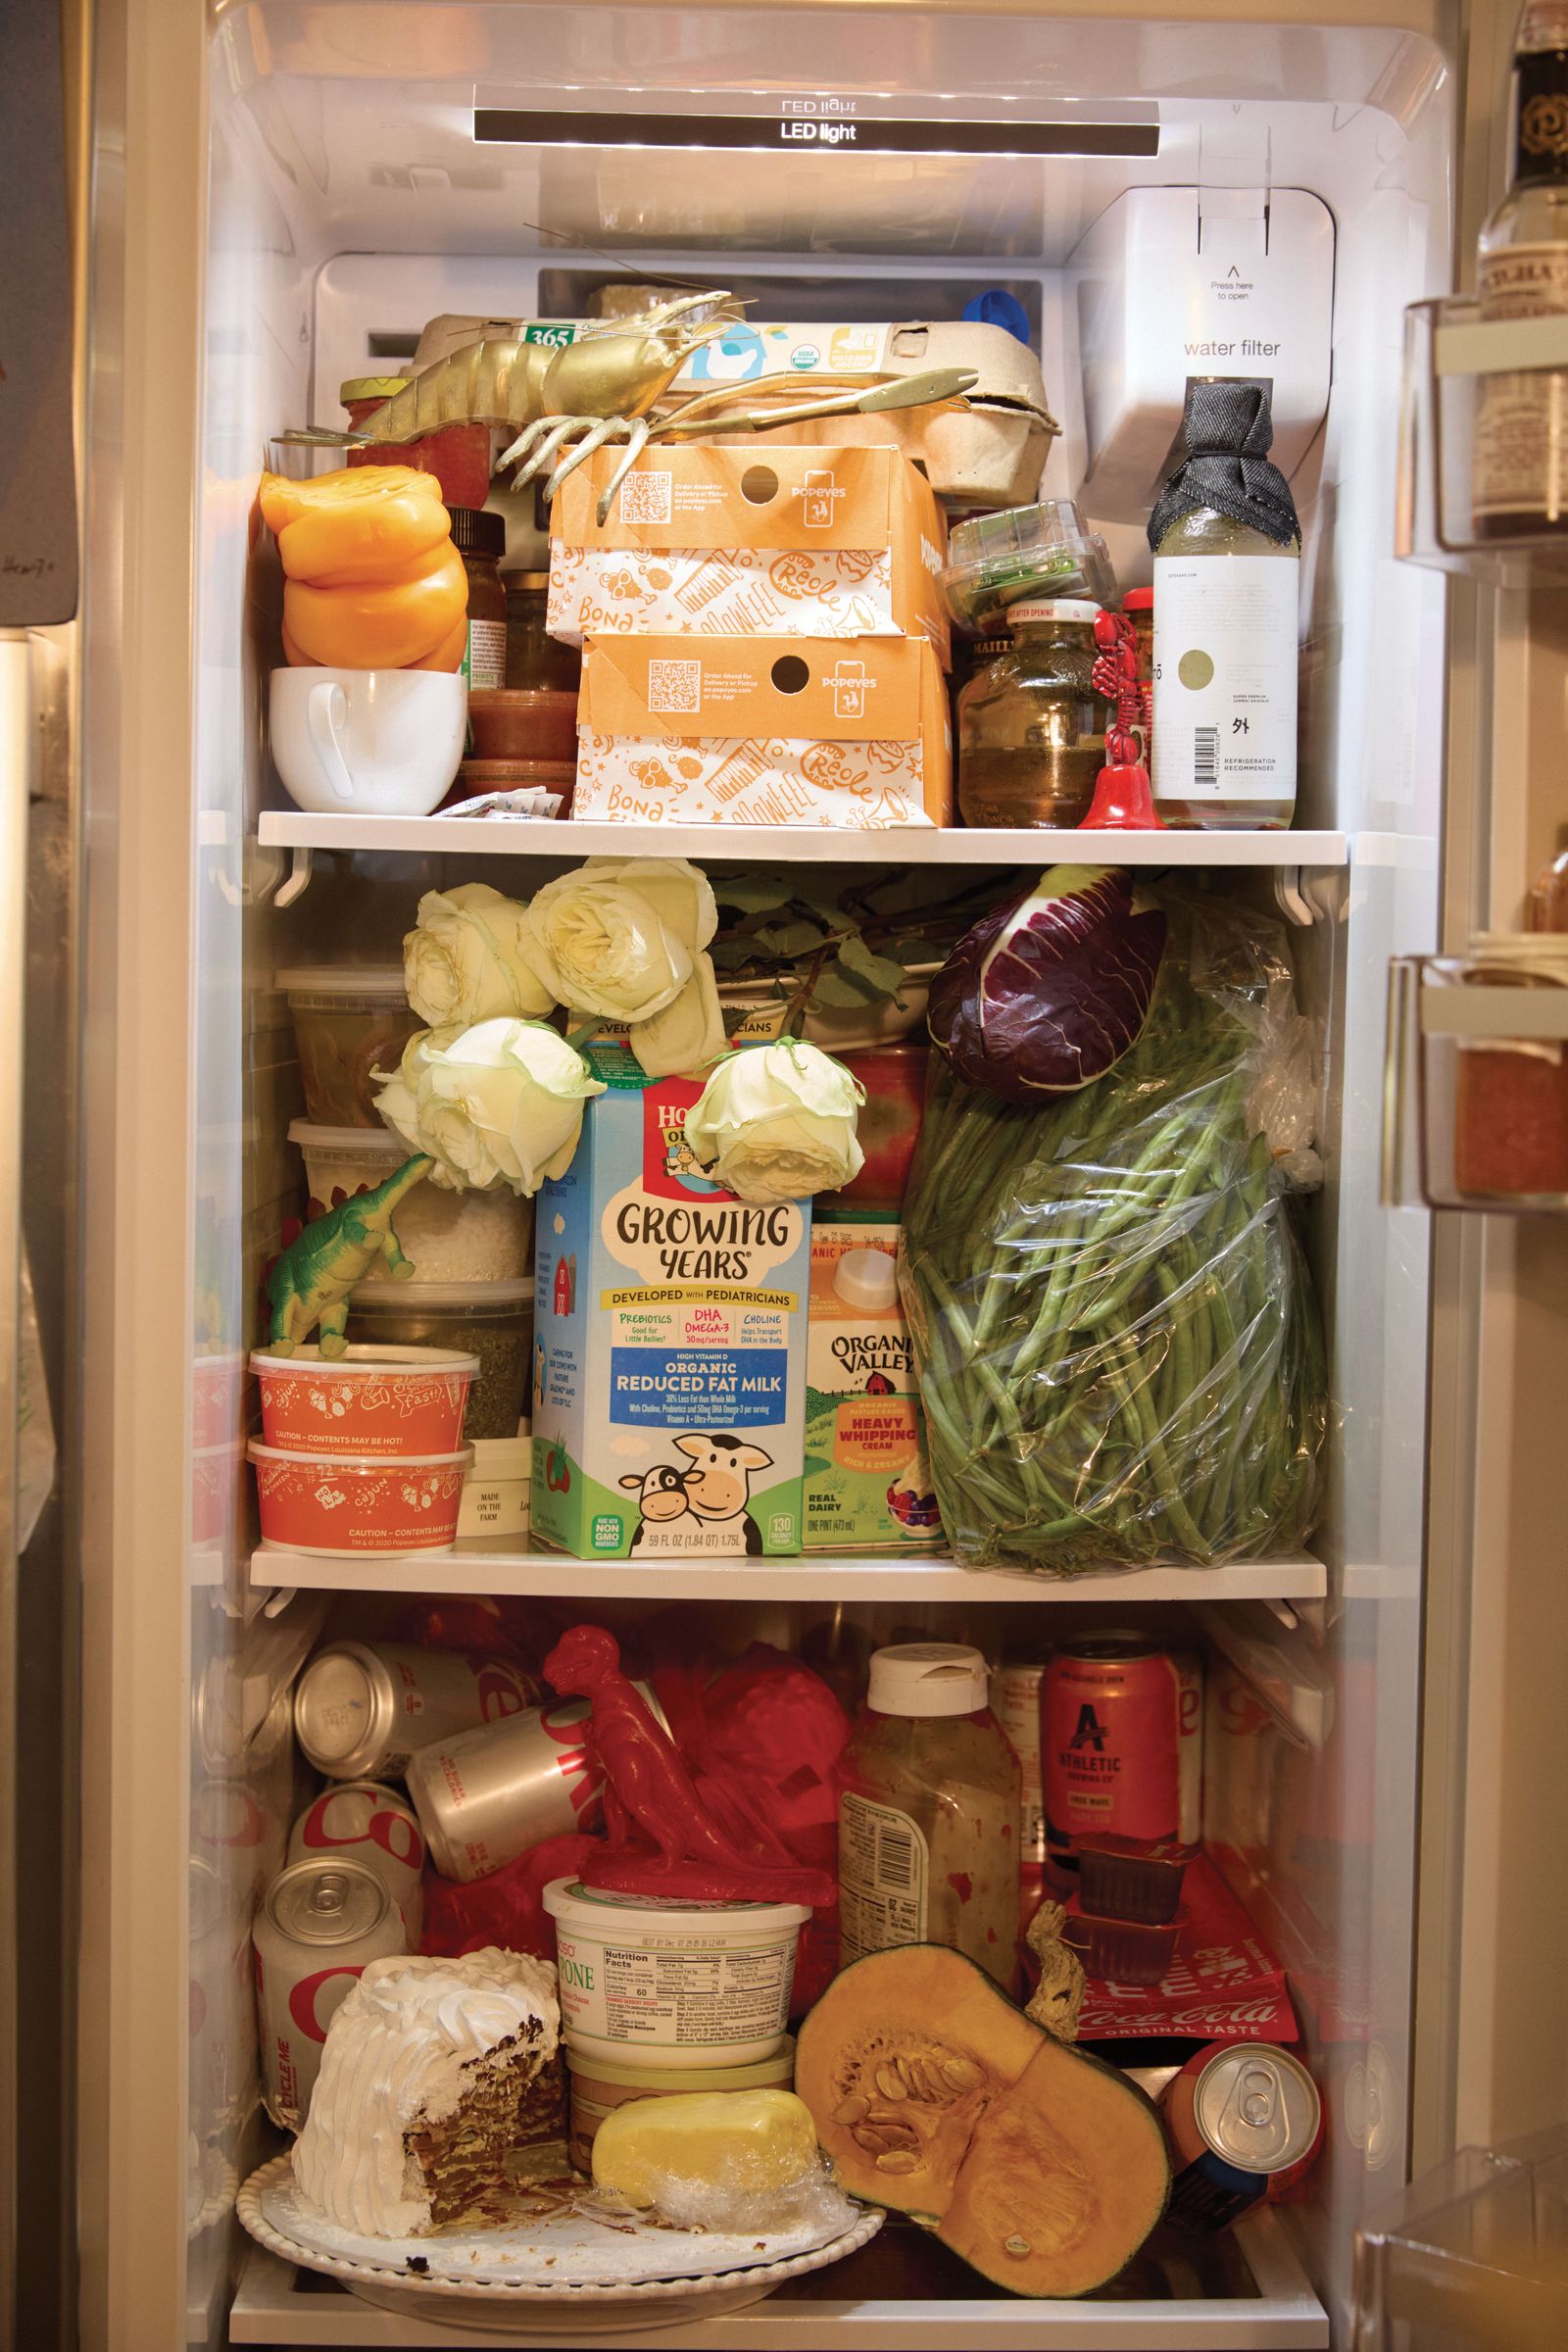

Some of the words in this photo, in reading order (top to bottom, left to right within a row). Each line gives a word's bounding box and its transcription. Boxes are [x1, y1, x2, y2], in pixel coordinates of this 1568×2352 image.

[781, 122, 816, 139] LED
[819, 122, 857, 144] light
[531, 328, 569, 348] 365
[1184, 340, 1236, 356] water
[1241, 339, 1281, 356] filter
[1031, 609, 1054, 617] OPENING
[1233, 717, 1250, 734] 外
[617, 1202, 790, 1247] GROWING
[812, 1249, 836, 1258] ANIC
[612, 1290, 683, 1303] DEVELOPED
[706, 1290, 790, 1305] PEDIATRICIANS
[619, 1313, 672, 1325] PREBIOTICS
[694, 1308, 722, 1322] DHA
[743, 1314, 782, 1325] CHOLINE
[685, 1323, 729, 1334] OMEGA-3
[831, 1335, 914, 1358] ORGANI
[665, 1362, 737, 1374] ORGANIC
[839, 1353, 914, 1374] VALLEY
[617, 1376, 705, 1392] REDUCED
[709, 1376, 738, 1392] FAT
[741, 1376, 782, 1392] MILK
[678, 1395, 690, 1403] Less
[698, 1395, 710, 1403] than
[710, 1395, 725, 1403] Whole
[725, 1395, 736, 1403] Milk
[629, 1403, 641, 1412] With
[662, 1404, 686, 1413] Prebiotics
[687, 1404, 697, 1413] and
[698, 1404, 711, 1414] 50mg
[711, 1404, 722, 1413] DHA
[723, 1404, 743, 1414] Omega-3
[744, 1405, 753, 1415] per
[753, 1405, 769, 1415] serving
[852, 1418, 904, 1429] HEAVY
[276, 1431, 302, 1441] CAUTION
[308, 1435, 351, 1444] CONTENTS
[839, 1430, 916, 1442] WHIPPING
[844, 1456, 864, 1468] RICH
[772, 1518, 790, 1531] 130
[808, 1519, 819, 1531] ONE
[819, 1519, 832, 1531] PINT
[394, 1527, 431, 1537] CONTENTS
[596, 1533, 619, 1542] GMO
[649, 1535, 659, 1546] 59
[661, 1535, 670, 1546] FL
[672, 1535, 682, 1546] OZ
[685, 1535, 704, 1548] (1.84
[706, 1535, 718, 1548] QT)
[721, 1535, 741, 1546] 1.75L
[1059, 1752, 1121, 1772] ATHLETIC
[606, 1950, 649, 1962] Nutrition
[1105, 2025, 1198, 2036] ORIGINAL
[1203, 2025, 1262, 2035] TASTE
[277, 2036, 289, 2062] ME
[277, 2066, 290, 2110] CYCLE
